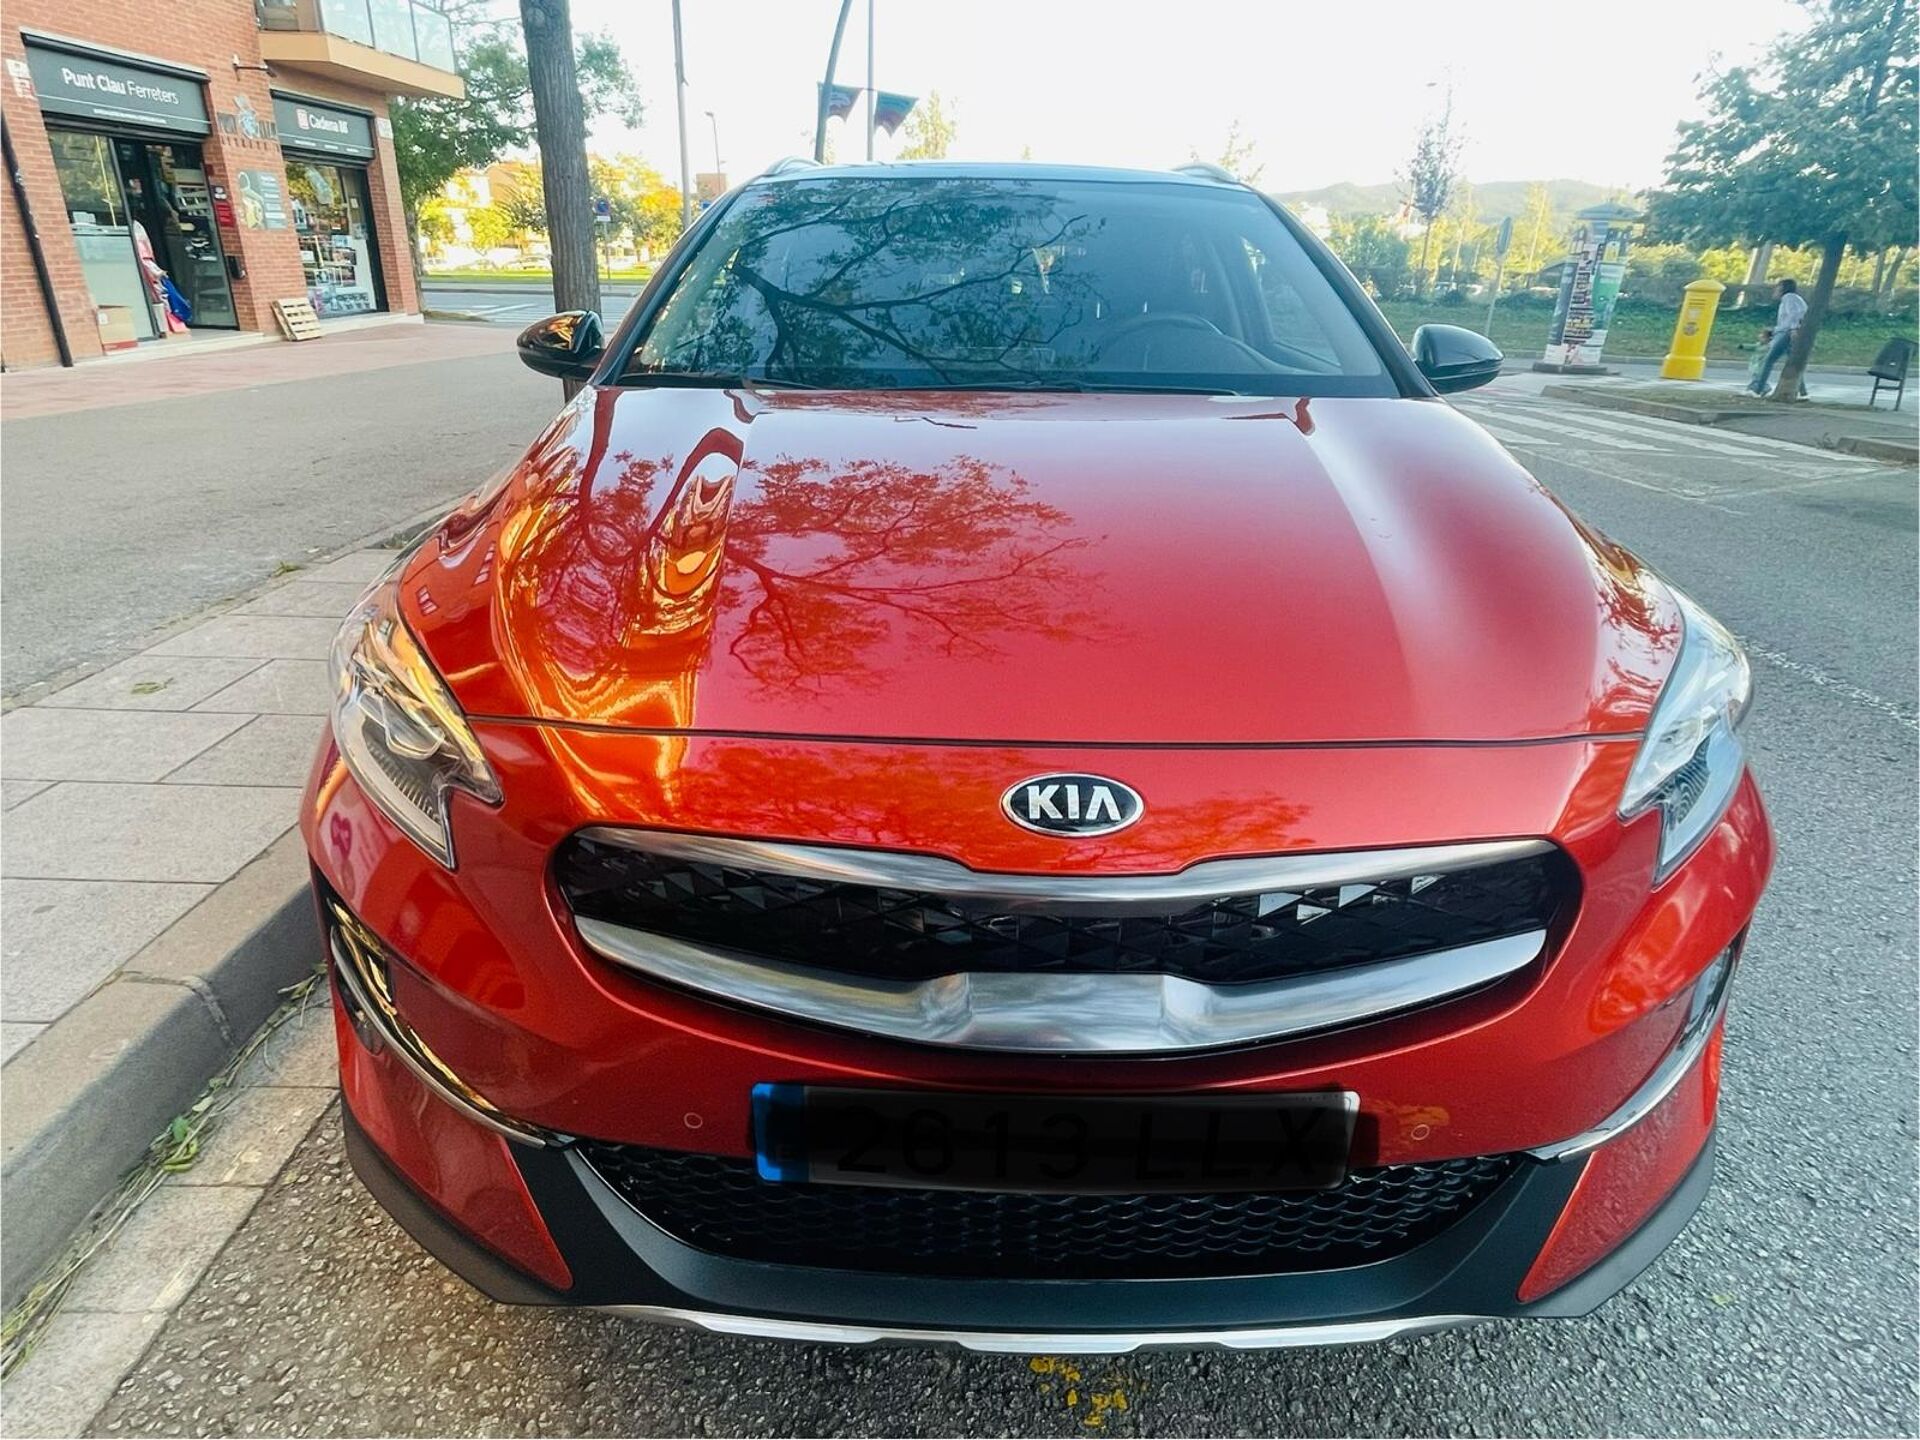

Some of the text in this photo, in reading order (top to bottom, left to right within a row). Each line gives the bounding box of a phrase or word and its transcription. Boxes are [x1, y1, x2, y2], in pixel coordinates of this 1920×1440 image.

[61, 67, 180, 105] Punt Clau Ferreters
[1027, 783, 1122, 821] KIA
